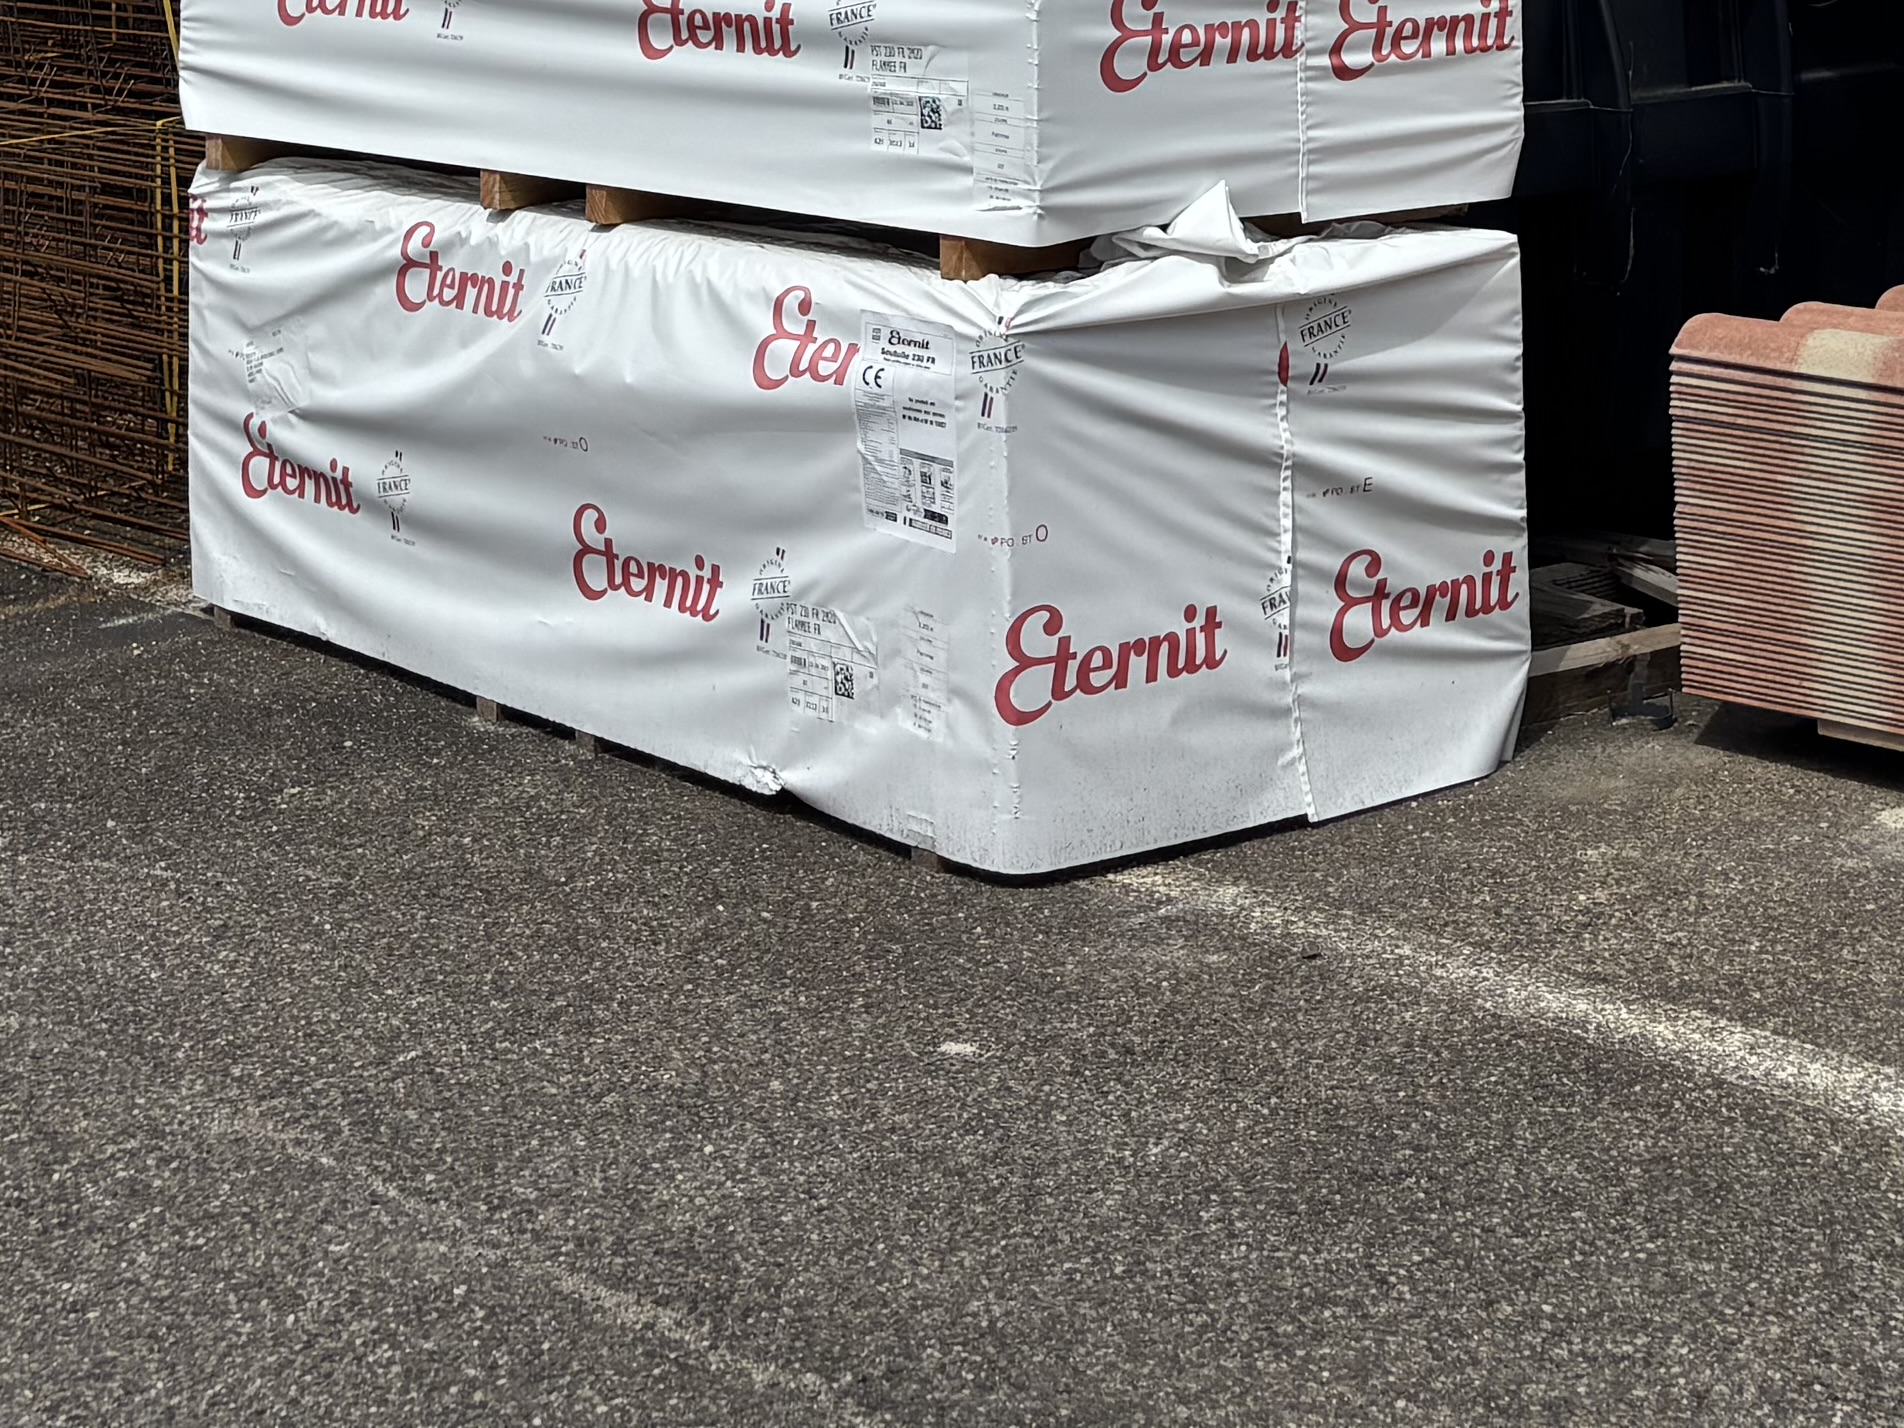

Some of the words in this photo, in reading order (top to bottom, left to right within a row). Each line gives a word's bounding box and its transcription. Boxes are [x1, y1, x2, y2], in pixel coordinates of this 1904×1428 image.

[829, 4, 874, 27] FRANCE
[396, 221, 525, 322] Eternit
[971, 345, 1023, 371] FRANCE
[1300, 311, 1349, 343] FRANCE
[241, 412, 360, 514] Eternit
[573, 503, 724, 622] Eternit
[752, 579, 790, 597] FRANCE
[1330, 549, 1520, 663] Eternit
[994, 604, 1227, 727] Eternit
